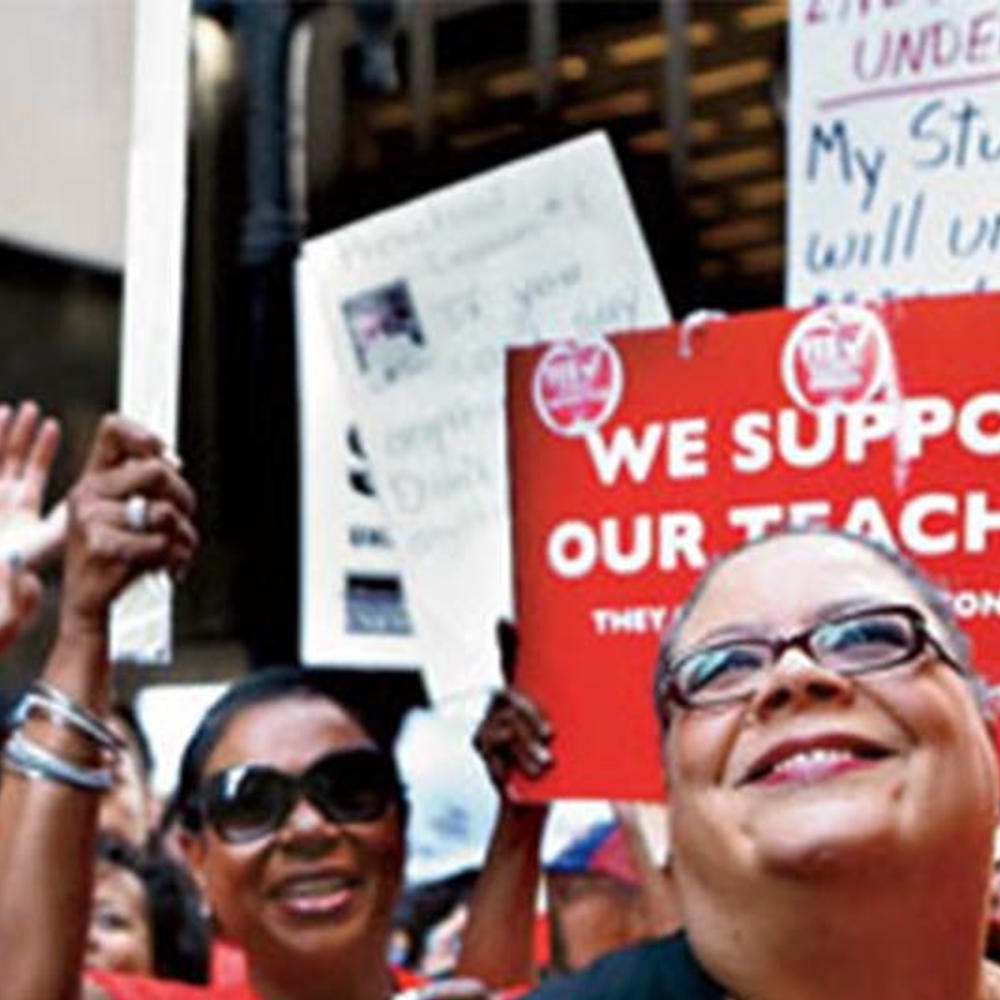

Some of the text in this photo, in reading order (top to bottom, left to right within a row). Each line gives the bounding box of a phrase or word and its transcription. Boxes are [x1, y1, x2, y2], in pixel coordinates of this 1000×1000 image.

[807, 121, 884, 213] My
[805, 191, 923, 275] will
[587, 391, 1000, 485] WE SUPPO
[546, 511, 707, 578] OUR
[591, 606, 667, 634] THEY
